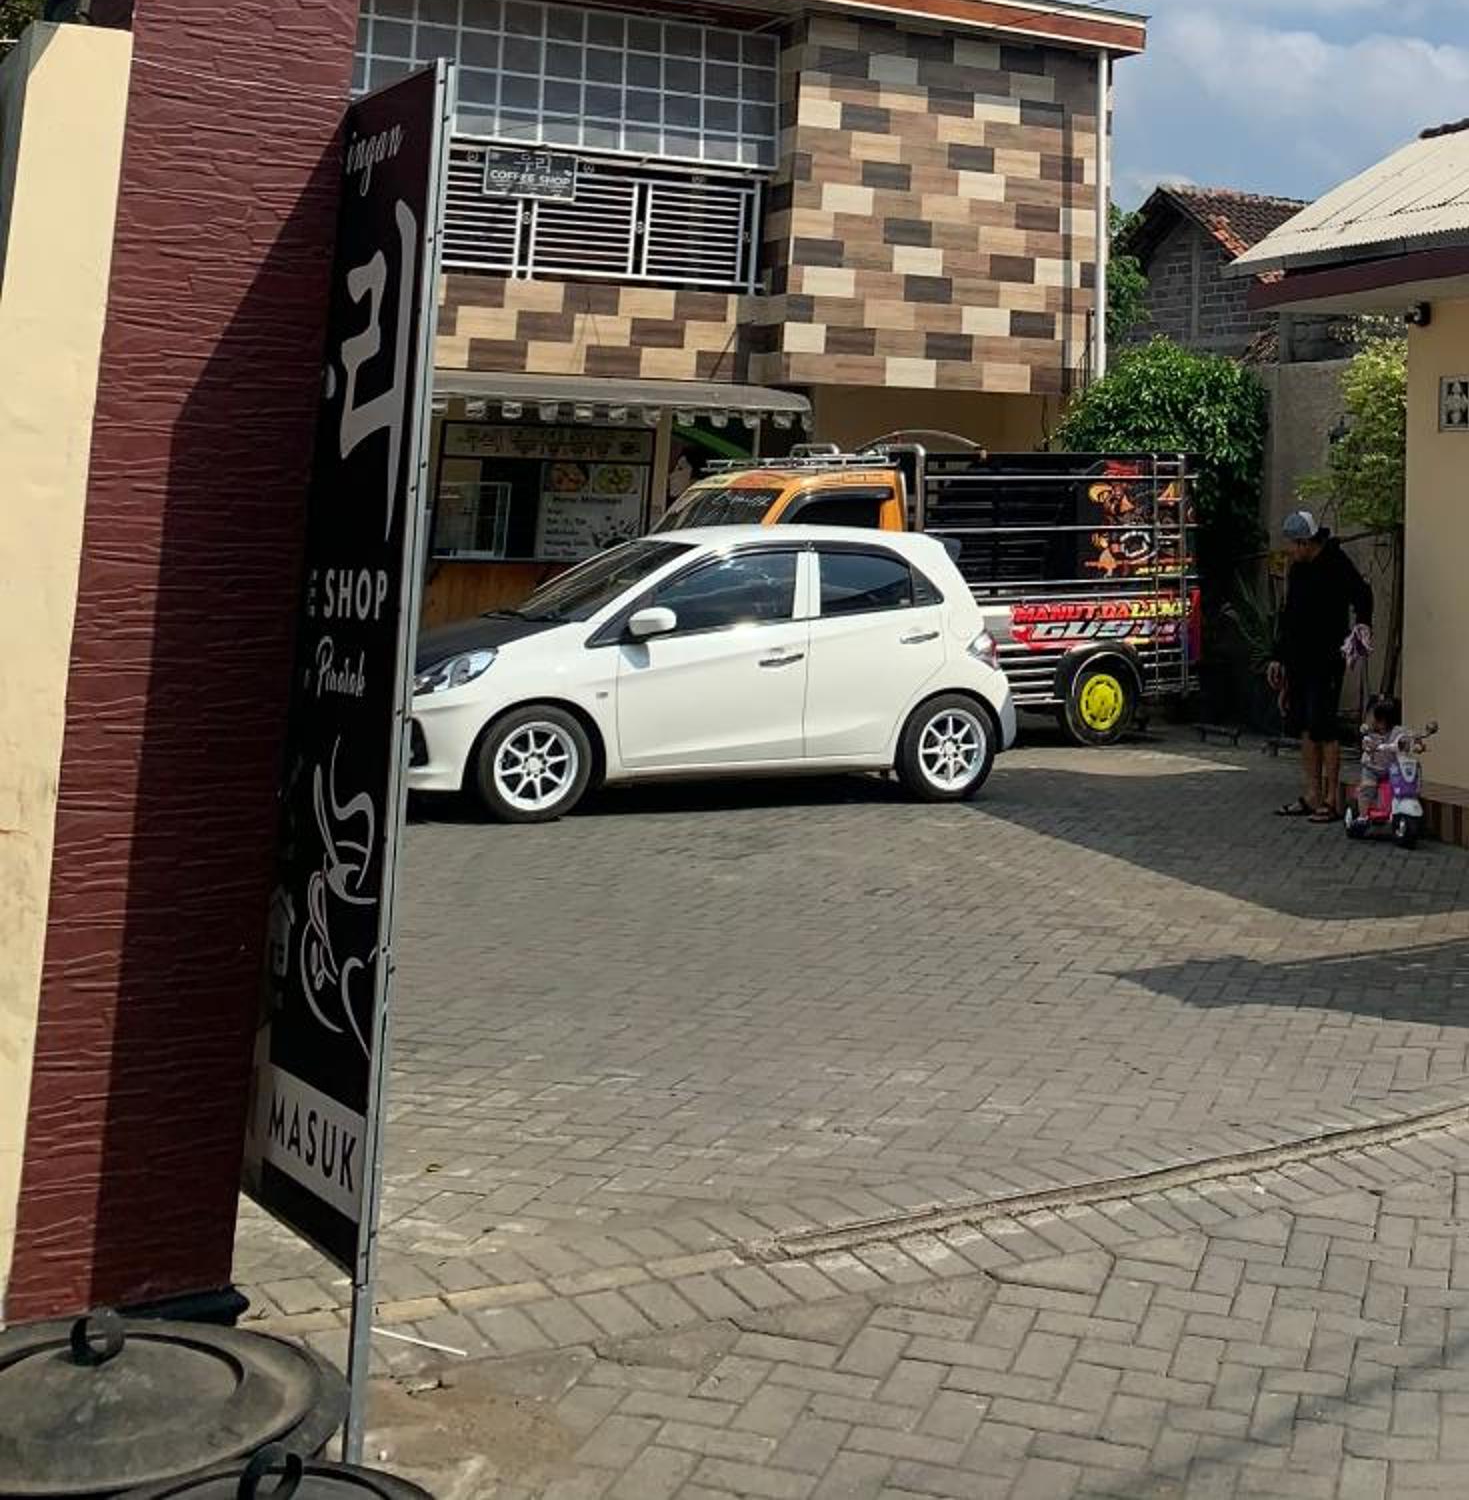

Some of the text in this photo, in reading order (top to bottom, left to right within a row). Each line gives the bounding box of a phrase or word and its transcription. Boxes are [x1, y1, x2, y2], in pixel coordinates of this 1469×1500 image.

[345, 123, 403, 197] ingan
[490, 169, 536, 183] COFFEE
[323, 568, 389, 621] SHOP
[268, 1089, 357, 1193] MASUK
